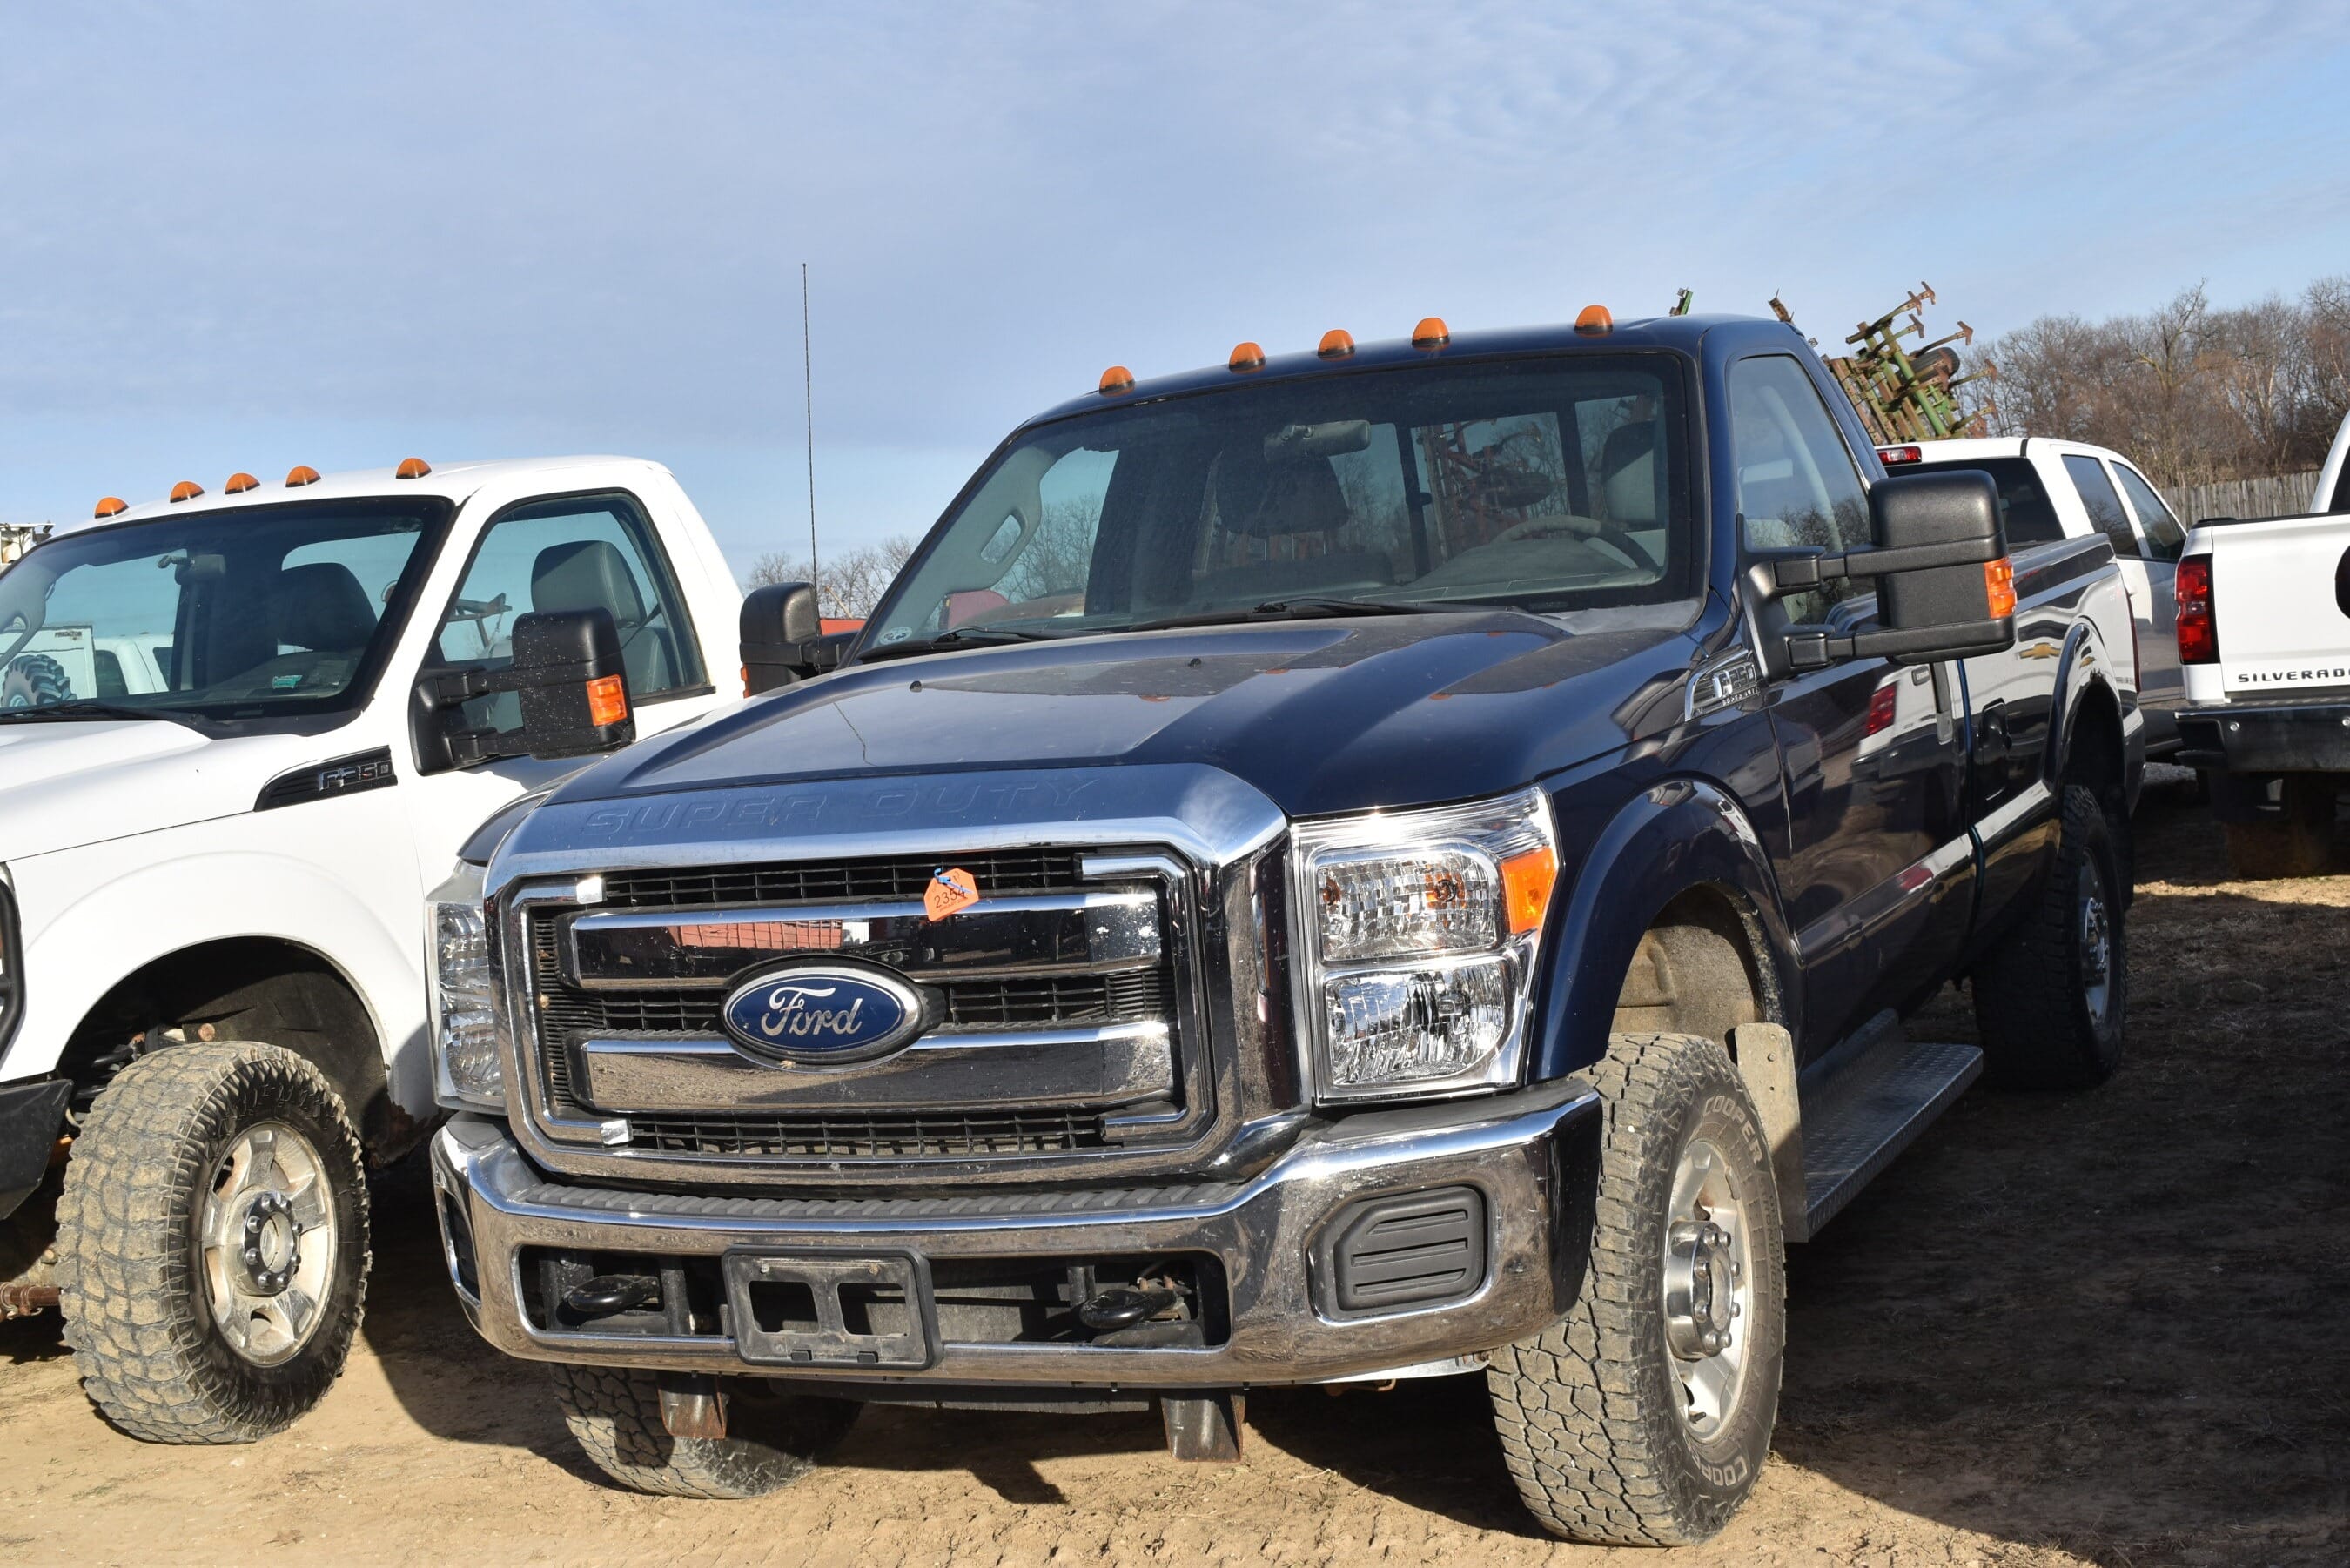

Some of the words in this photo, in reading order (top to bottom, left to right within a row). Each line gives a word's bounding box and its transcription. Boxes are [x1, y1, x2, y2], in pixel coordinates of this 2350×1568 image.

[2238, 668, 2350, 683] SILVERAD
[580, 793, 827, 835] SUPER
[860, 779, 1100, 819] DUTY
[761, 986, 863, 1037] Ford
[1705, 1095, 1763, 1166] COOPER
